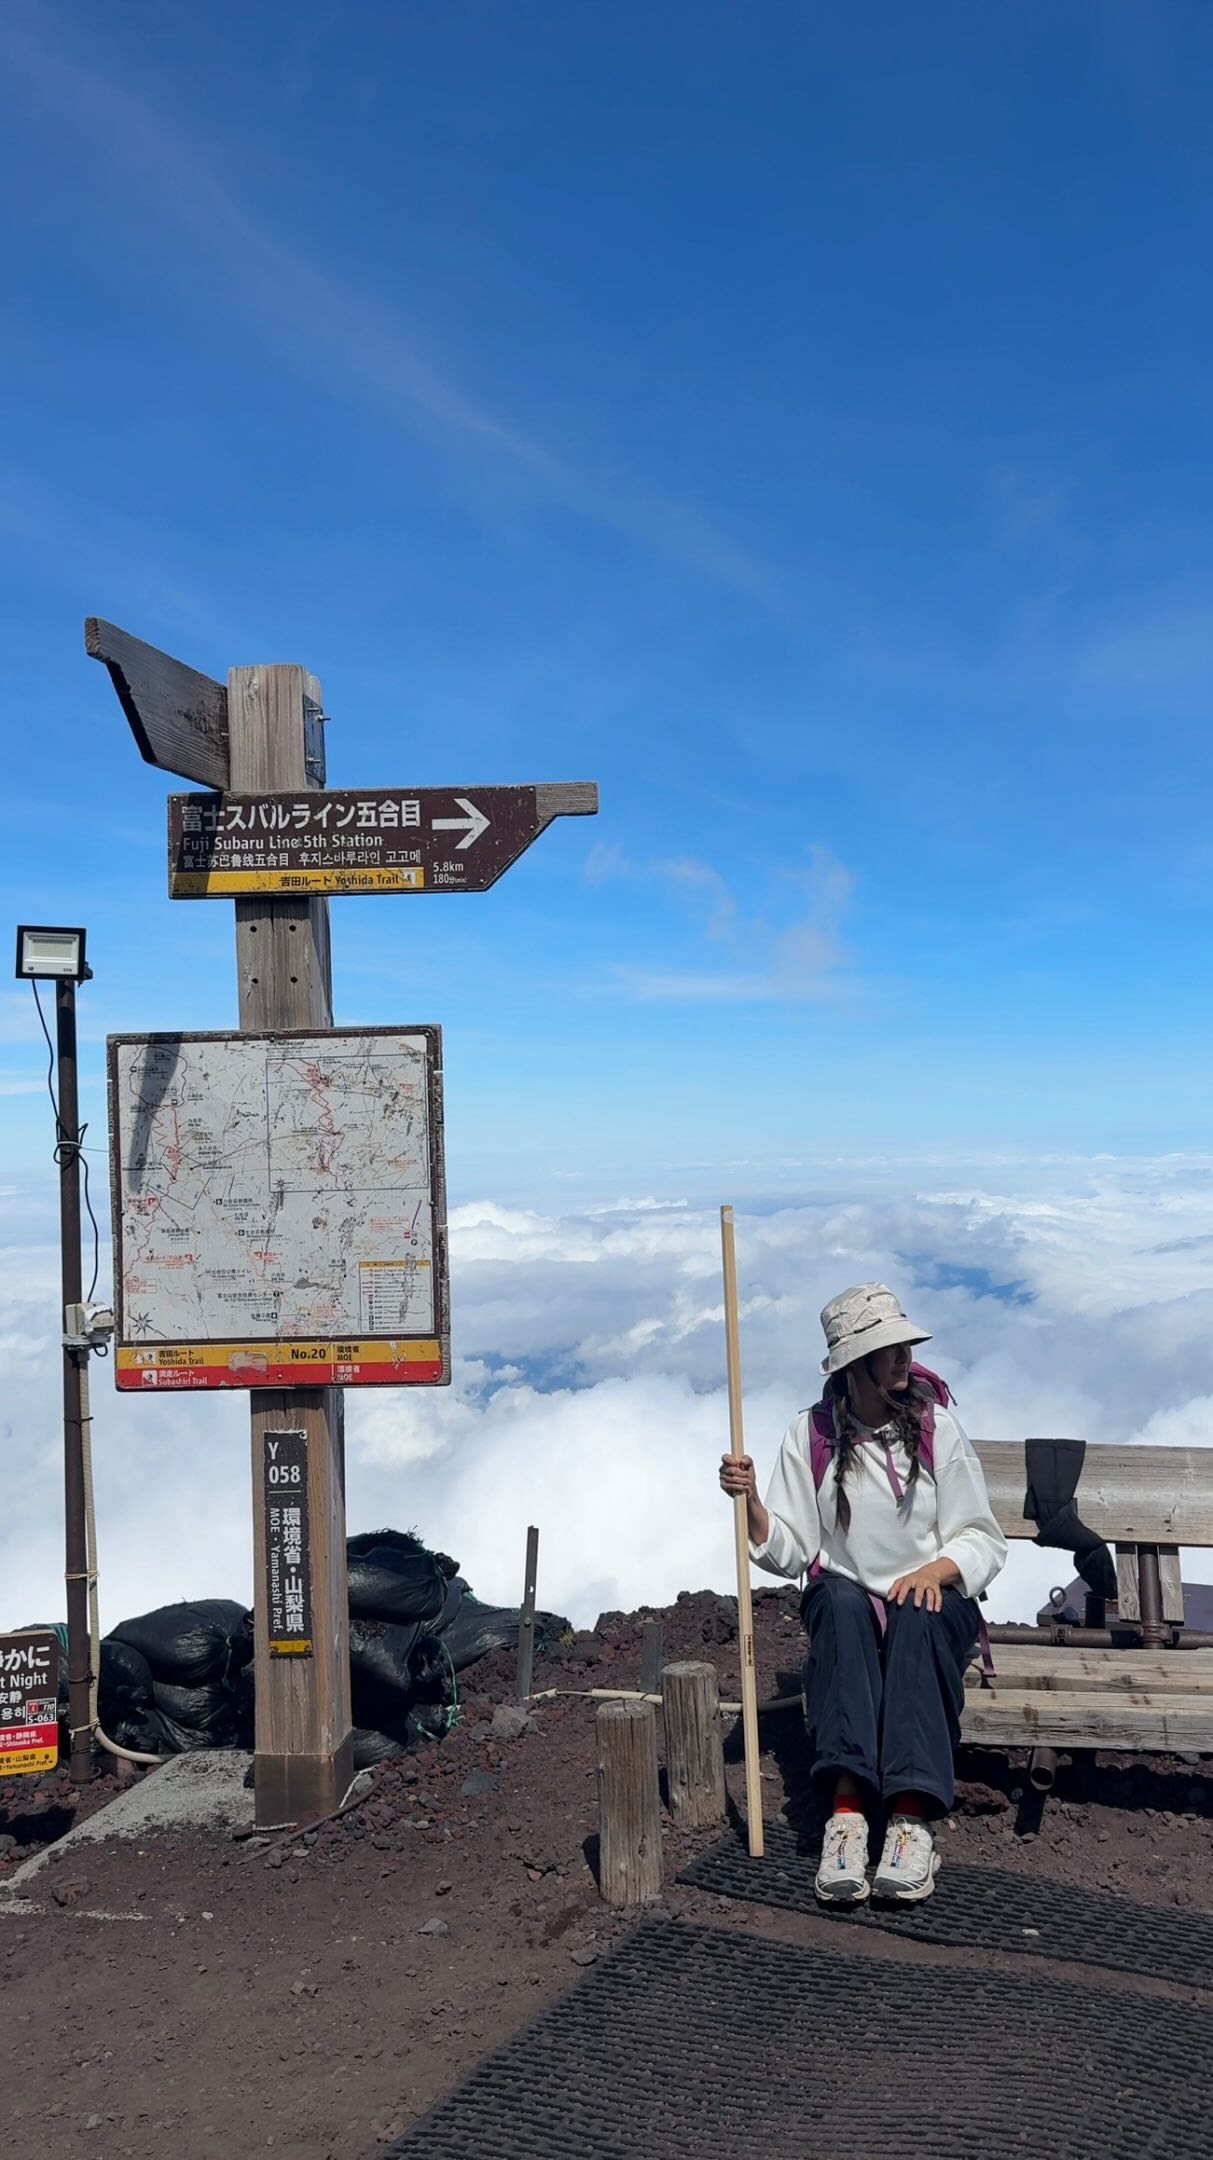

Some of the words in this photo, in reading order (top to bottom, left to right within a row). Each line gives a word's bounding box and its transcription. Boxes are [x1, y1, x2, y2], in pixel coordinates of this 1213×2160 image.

[181, 799, 421, 832] 富士スバルライン五合目
[183, 837, 210, 854] Fuji
[214, 835, 264, 851] Subaru
[269, 834, 300, 849] Line
[303, 833, 327, 848] 5th
[332, 832, 383, 848] Station
[433, 861, 464, 872] 5.8km
[280, 876, 332, 887] 吉田ルート
[335, 874, 374, 888] Yoshida
[376, 873, 399, 884] Trail
[158, 1357, 187, 1366] Yoshida
[188, 1356, 204, 1365] Trail
[291, 1349, 326, 1359] No.20
[192, 1376, 208, 1385] Trail
[267, 1442, 279, 1460] Y
[268, 1465, 301, 1483] 058
[270, 1507, 281, 1533] MOE
[271, 1545, 284, 1604] Yamanashi
[272, 1607, 284, 1633] Pref.
[9, 1671, 48, 1690] Night
